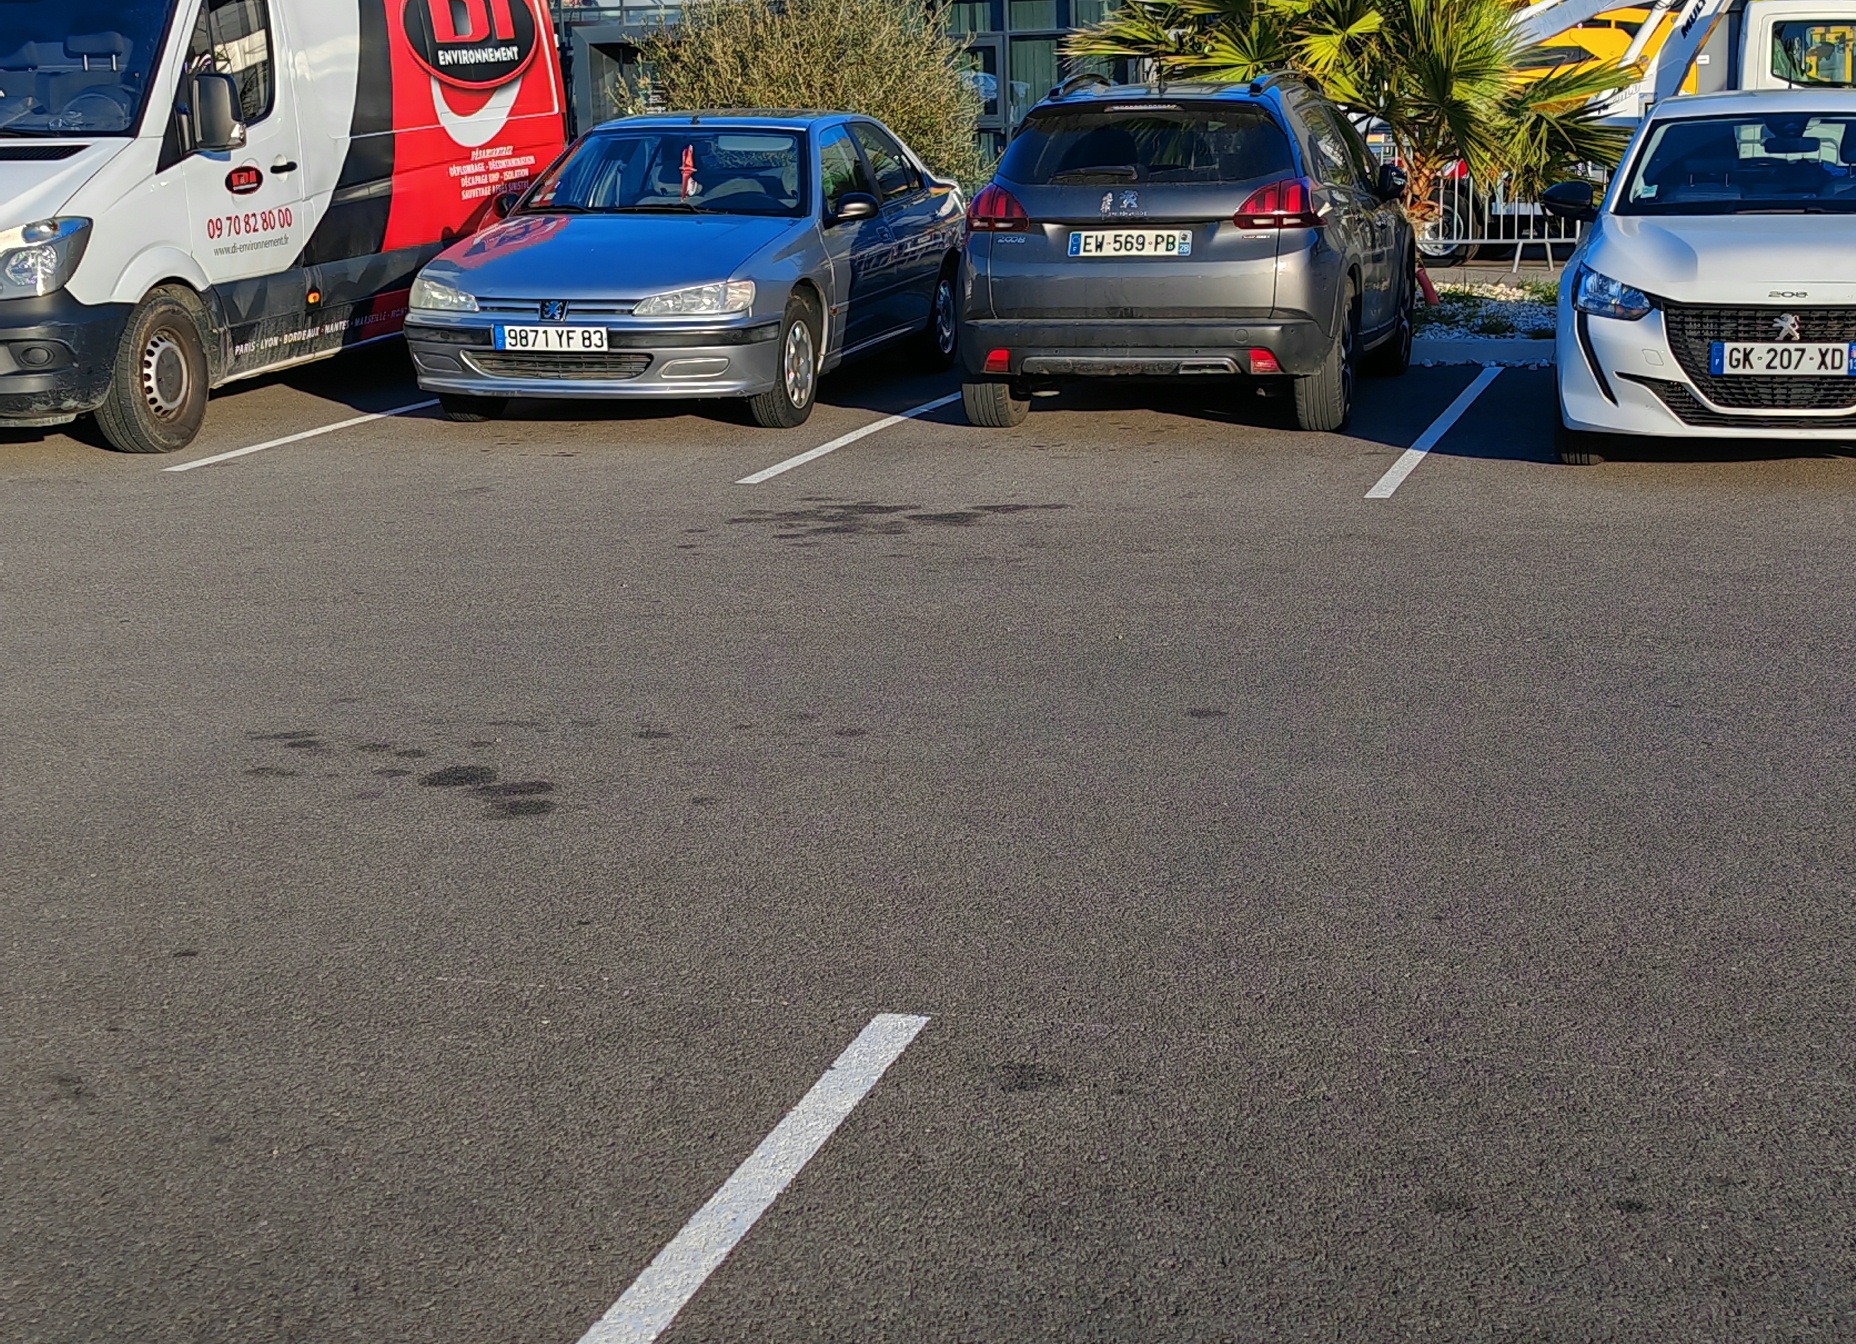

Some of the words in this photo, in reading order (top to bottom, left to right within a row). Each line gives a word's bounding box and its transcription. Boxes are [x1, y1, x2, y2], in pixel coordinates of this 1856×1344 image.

[438, 46, 519, 66] ENVIRONNEMENT
[207, 218, 223, 239] 09
[226, 215, 241, 237] 70
[244, 212, 259, 234] 82
[261, 210, 276, 232] 80
[278, 207, 293, 228] 00
[213, 234, 290, 257] www.di-environnement.fr
[234, 341, 256, 356] PARIS
[261, 336, 280, 350] LYON
[283, 326, 320, 344] BORDEAUX
[324, 319, 350, 335] NANTES
[508, 329, 549, 348] 9871
[555, 329, 576, 348] YF
[581, 330, 604, 348] 83
